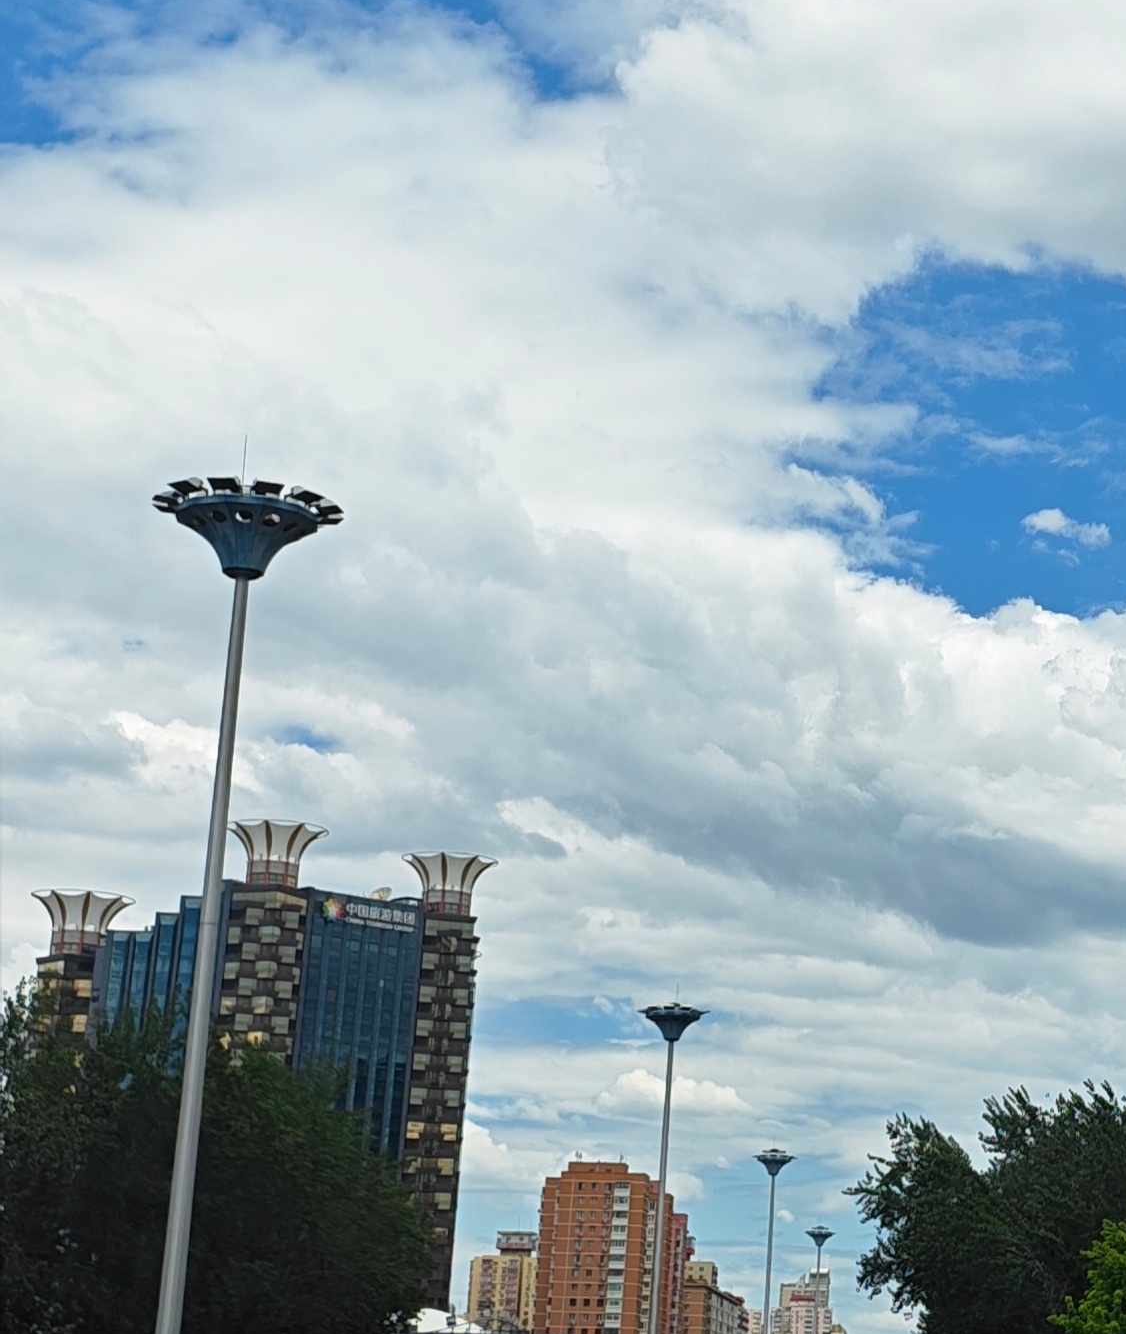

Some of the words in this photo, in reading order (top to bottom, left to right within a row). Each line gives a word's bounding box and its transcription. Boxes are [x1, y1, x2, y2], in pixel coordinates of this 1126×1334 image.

[346, 902, 416, 925] 中国旅游集团
